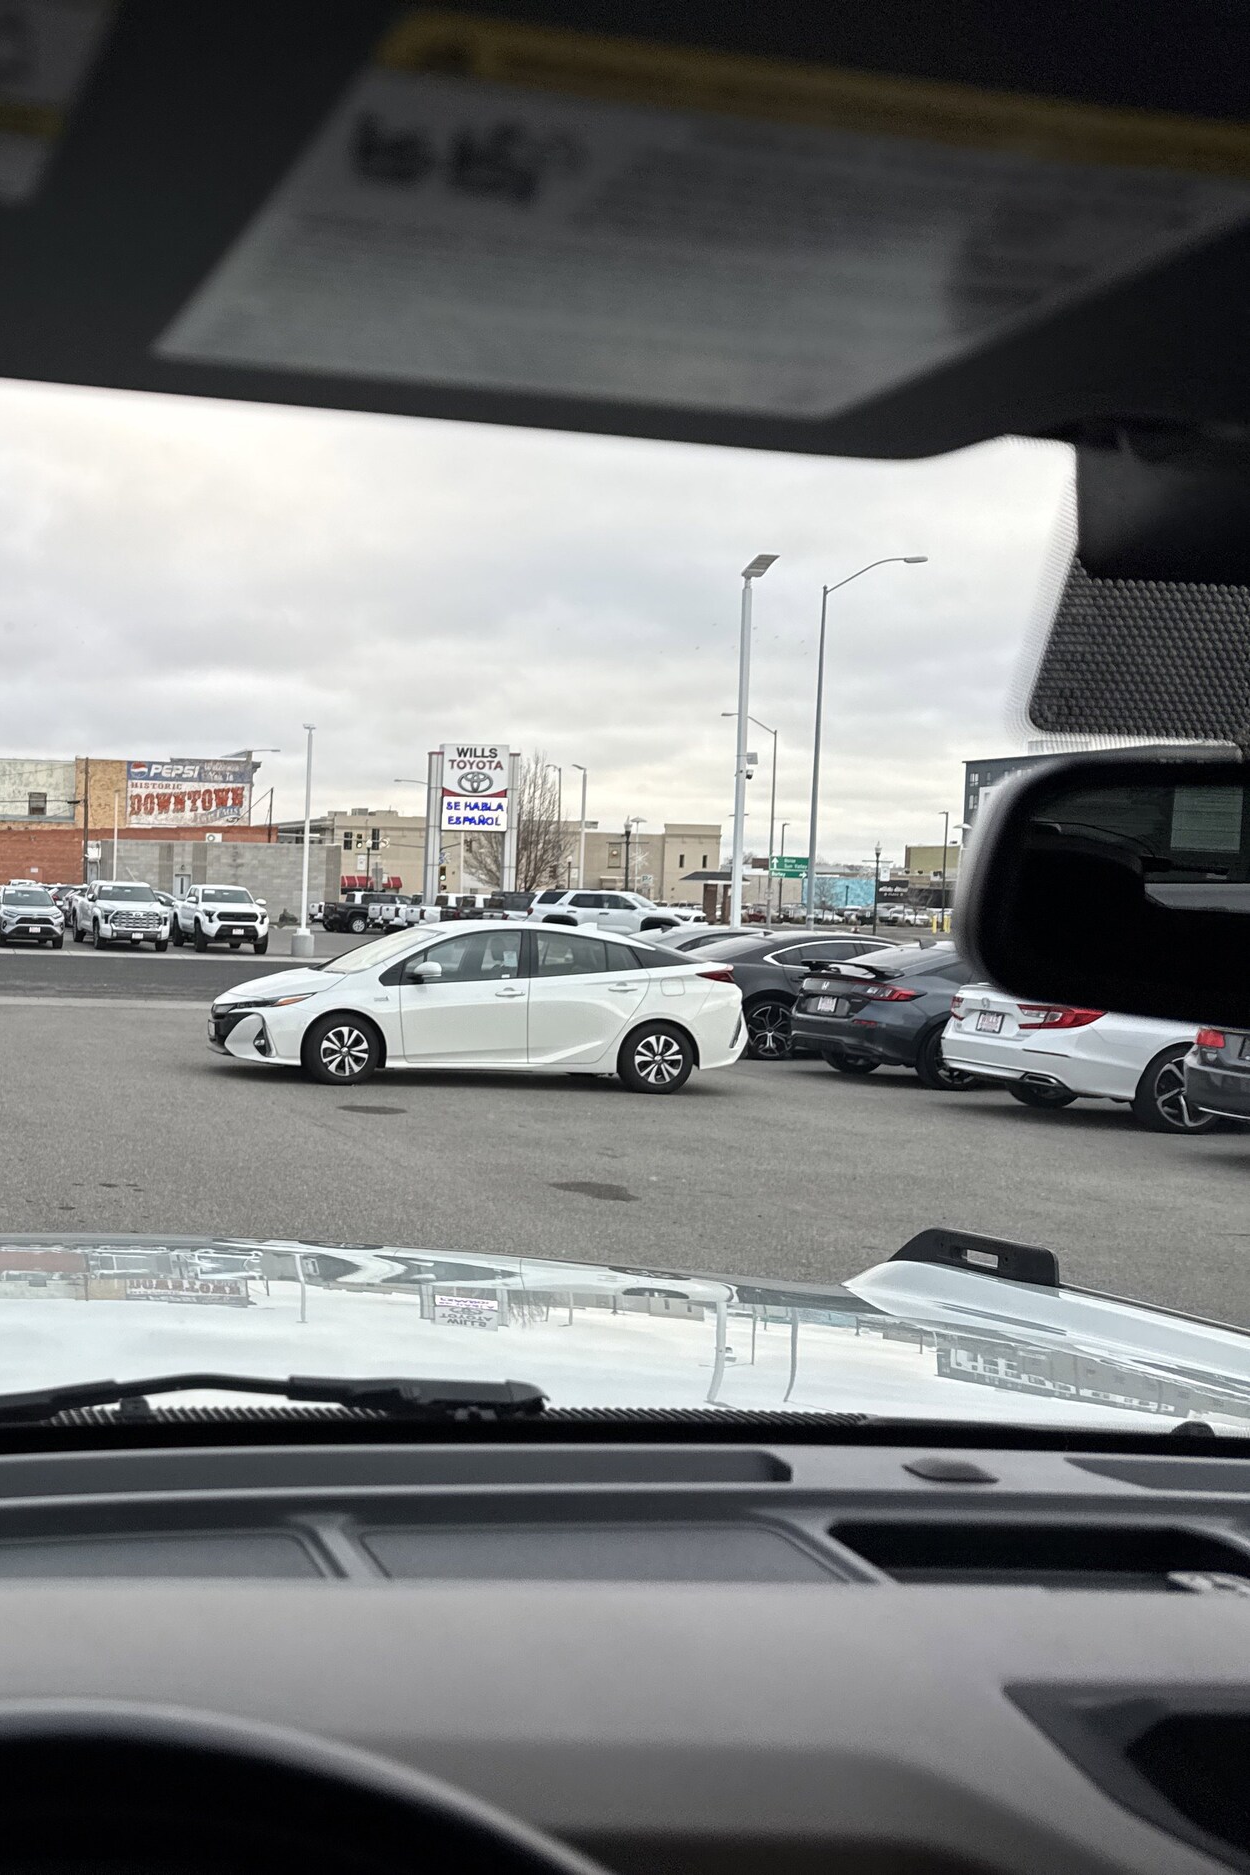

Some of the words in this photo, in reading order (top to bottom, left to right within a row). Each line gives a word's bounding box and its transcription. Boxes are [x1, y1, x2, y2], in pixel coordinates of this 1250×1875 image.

[456, 747, 498, 758] WILLS
[449, 759, 504, 771] TOYOTA
[150, 765, 199, 778] PEPSI
[130, 782, 183, 790] HISTORIC
[129, 786, 245, 816] DOWNTOWN
[446, 801, 461, 811] SE
[464, 802, 504, 812] HABLA
[447, 814, 501, 826] ESPAÑOL
